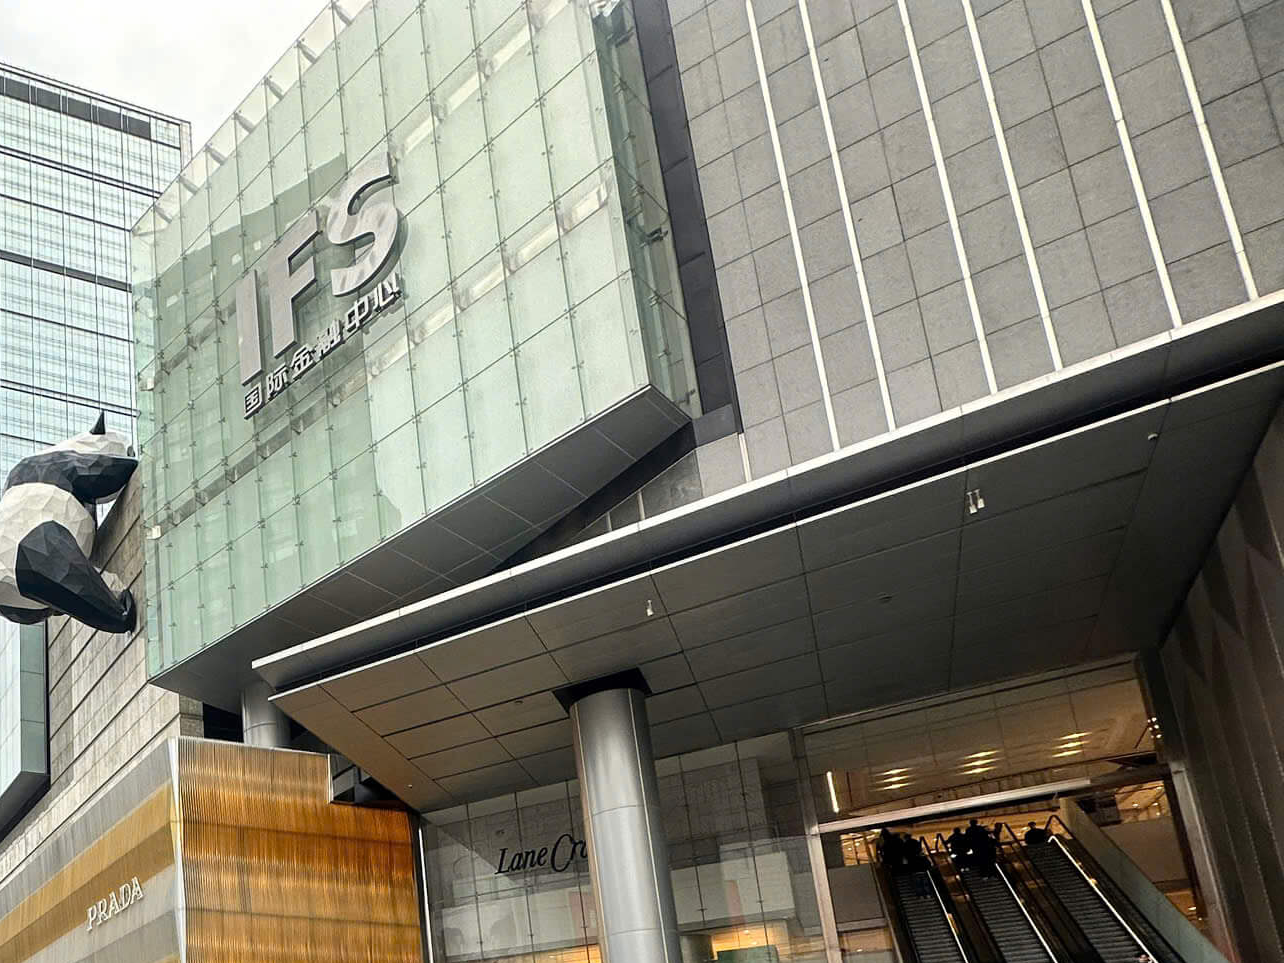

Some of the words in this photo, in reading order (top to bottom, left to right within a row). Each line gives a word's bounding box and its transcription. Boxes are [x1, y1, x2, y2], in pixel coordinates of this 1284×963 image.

[236, 151, 408, 386] IFS
[244, 273, 404, 420] 国际金融中心
[86, 876, 144, 932] PRADA
[494, 847, 548, 875] Lane
